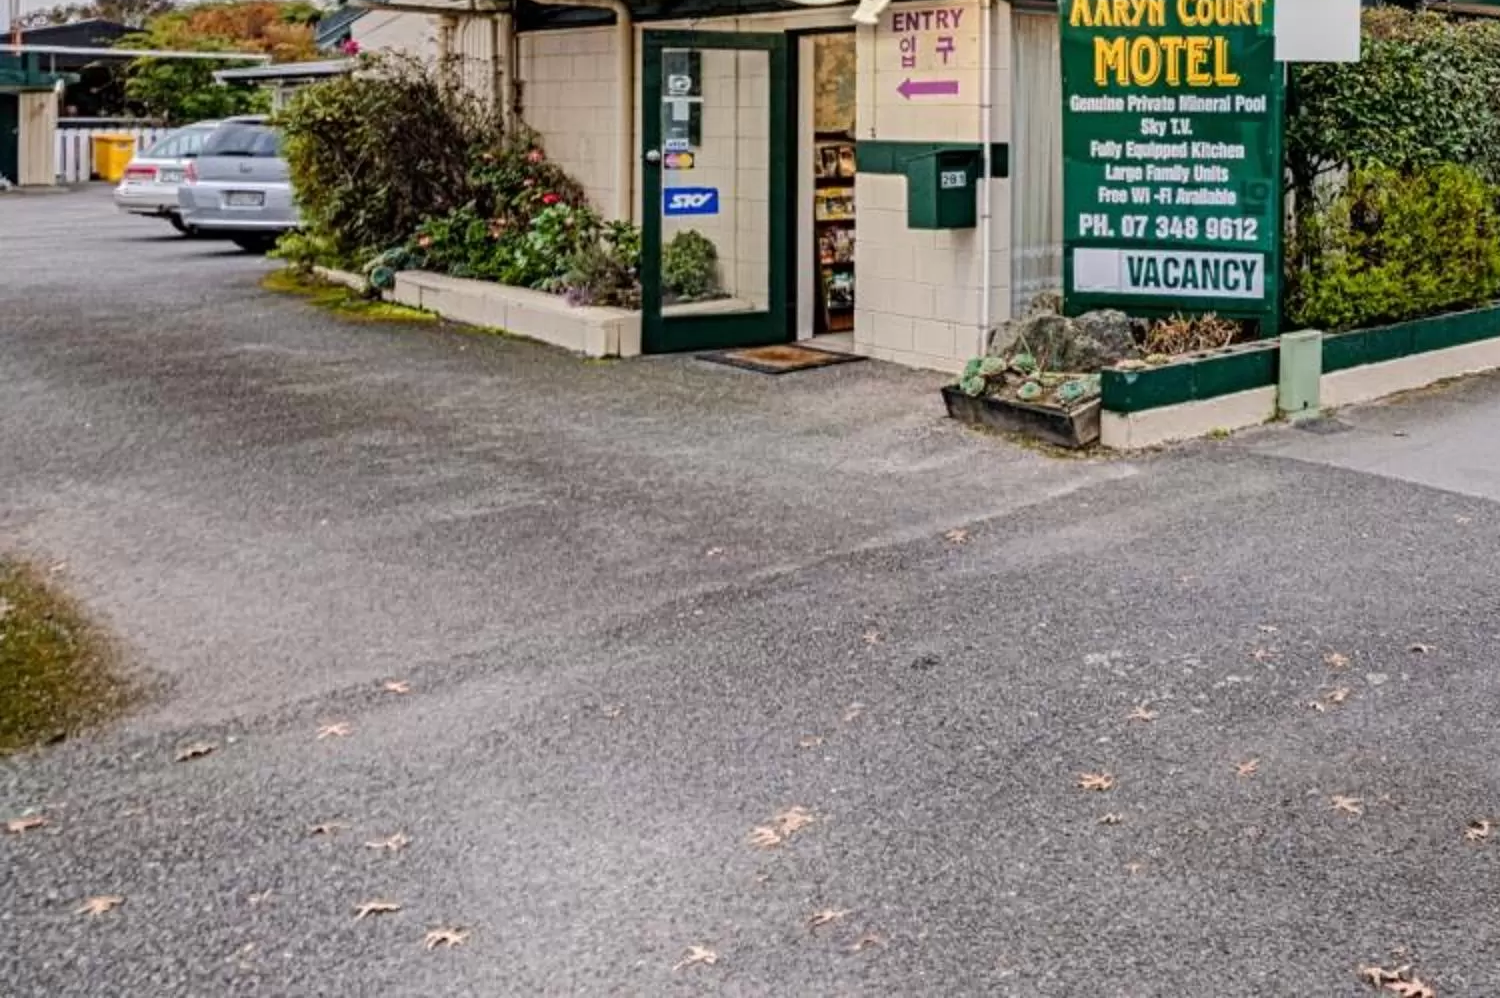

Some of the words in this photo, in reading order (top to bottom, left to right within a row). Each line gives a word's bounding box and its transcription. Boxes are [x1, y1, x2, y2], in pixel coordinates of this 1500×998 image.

[892, 8, 965, 32] ENTRY
[1094, 35, 1240, 87] MOTEL
[1070, 94, 1125, 112] Genuine
[1127, 94, 1176, 112] Private
[1179, 95, 1231, 112] Mineral
[1235, 95, 1266, 113] Pool
[1140, 118, 1166, 136] Sky
[1090, 140, 1122, 160] Fully
[1125, 141, 1187, 160] Equipped
[1191, 141, 1245, 159] Kitchen
[1105, 164, 1141, 182] Large
[1146, 164, 1190, 182] Family
[1194, 165, 1229, 182] Units
[1098, 186, 1128, 203] Free
[1175, 188, 1237, 205] Available
[1079, 214, 1115, 237] PH.
[1121, 215, 1149, 238] 07
[1155, 216, 1198, 239] 348
[1205, 217, 1259, 241] 9612
[1127, 255, 1258, 292] VACANCY
